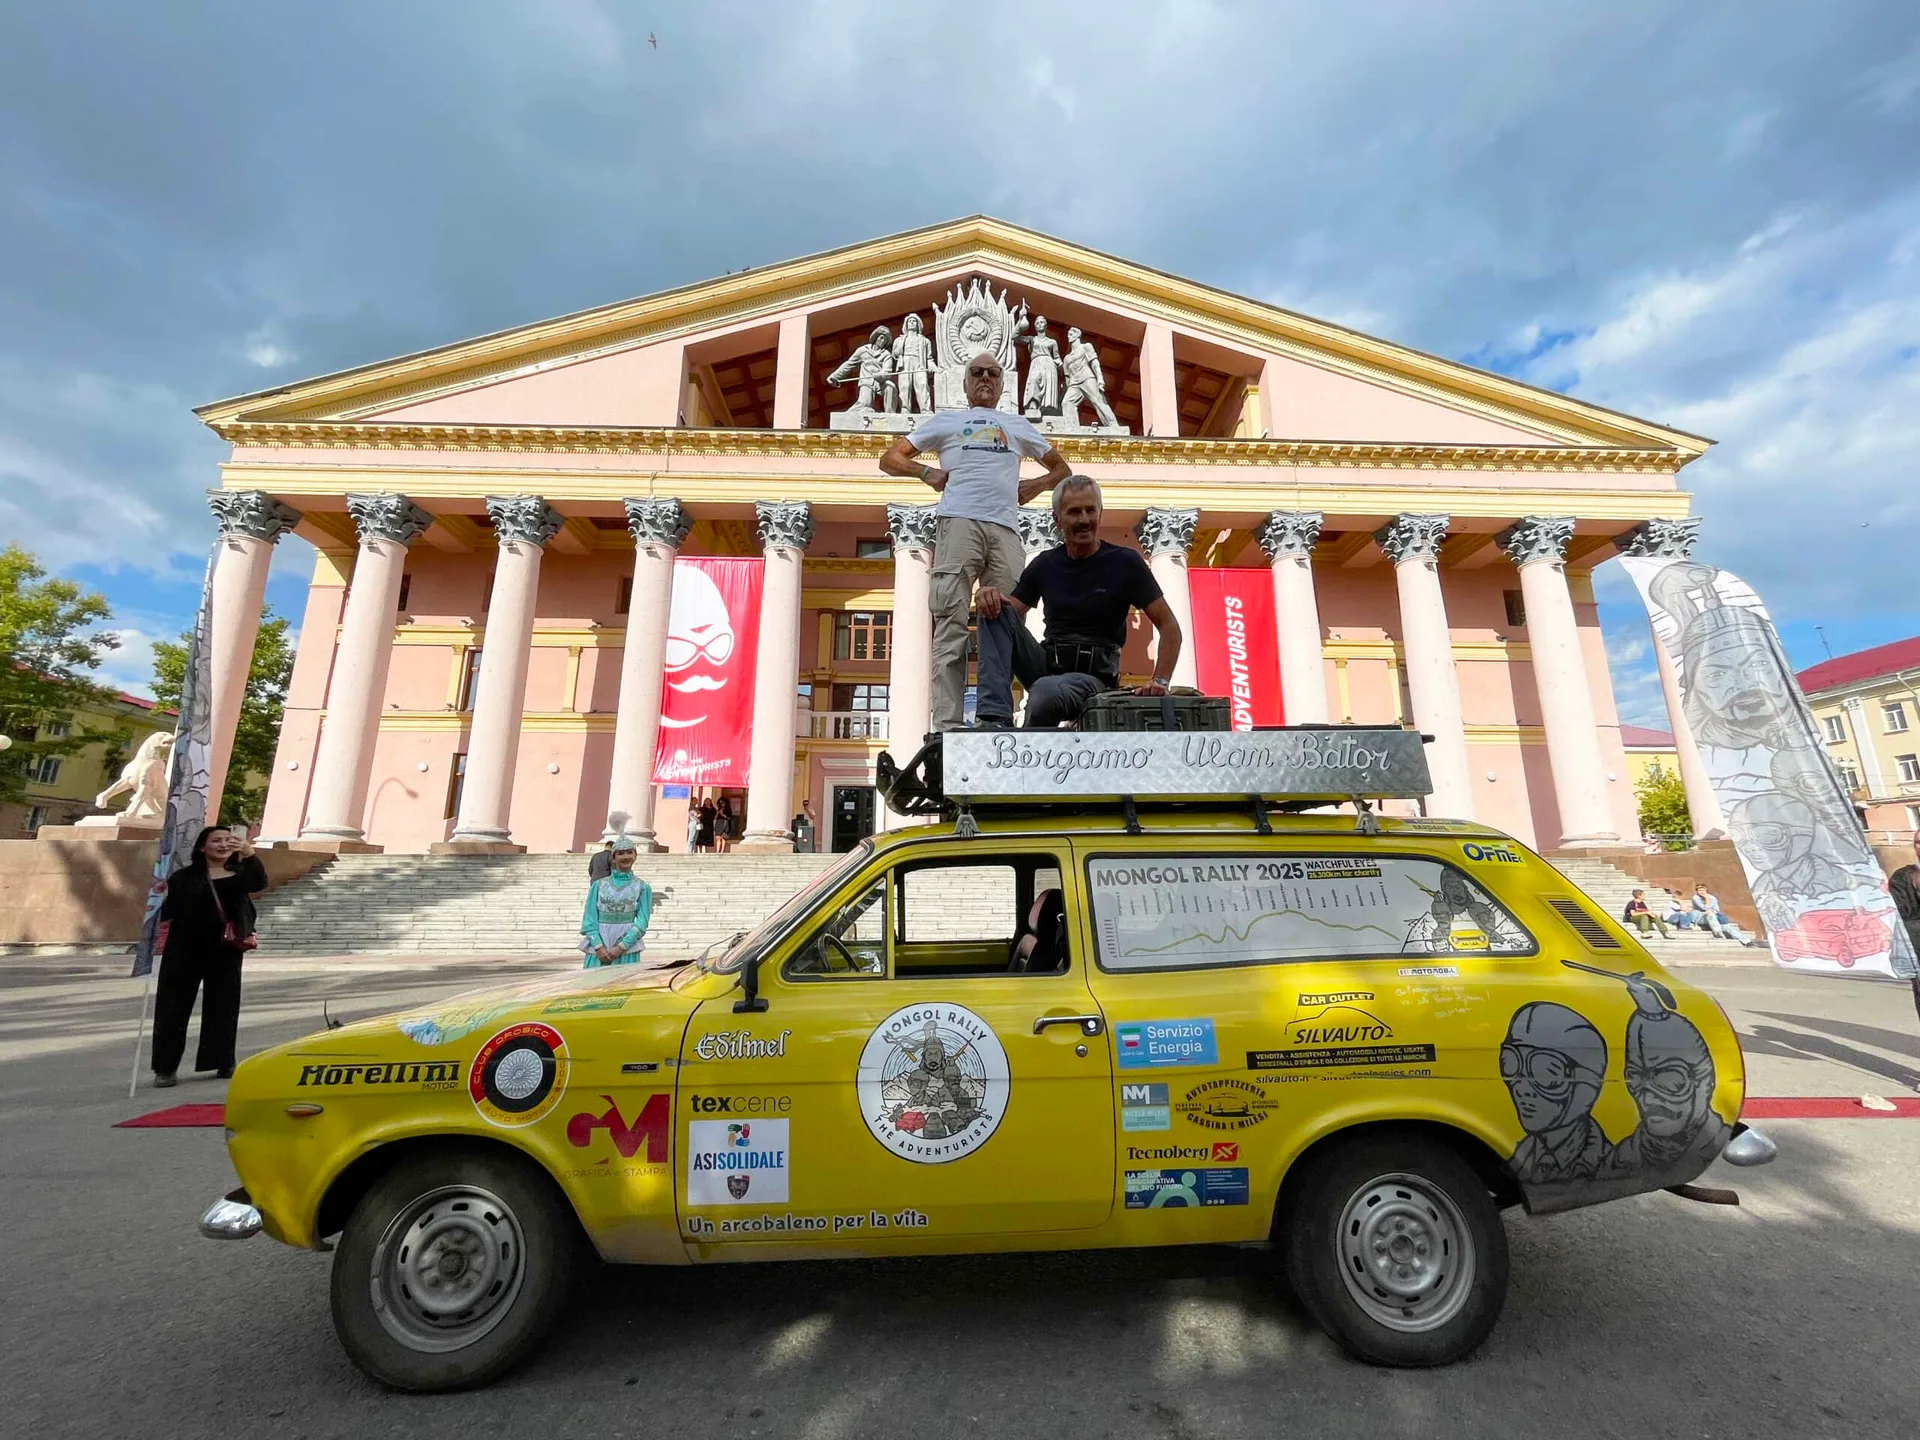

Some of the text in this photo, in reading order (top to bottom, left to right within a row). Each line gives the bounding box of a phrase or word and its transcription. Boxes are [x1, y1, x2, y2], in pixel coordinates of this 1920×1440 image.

[1225, 596, 1254, 731] ADVENTURISTS
[986, 733, 1153, 784] Bergamo
[1182, 734, 1274, 768] Ulan
[1305, 858, 1377, 869] WATCHFUL EYES
[1354, 869, 1380, 877] charity
[1096, 863, 1305, 887] MONGOL RALLY 2025
[1301, 993, 1373, 1005] CAR OUTLET
[881, 1009, 988, 1043] MONGOL RALLY
[1147, 1025, 1203, 1039] Servizio
[1294, 1025, 1385, 1044] SILVAUTO
[694, 1028, 792, 1060] Edilmel
[1149, 1041, 1203, 1056] Energia
[1290, 1051, 1331, 1059] ASSISTENZA
[1336, 1048, 1377, 1056] AUTOMOBILI
[473, 1026, 550, 1084] CLUB OROBICO
[1334, 1056, 1369, 1064] COLLEZIONE
[297, 1061, 462, 1086] Morellini
[1186, 1080, 1266, 1101] AUTOTAPPEZZERIA
[691, 1094, 792, 1114] texcene
[1187, 1112, 1227, 1130] CASSINA
[1230, 1121, 1235, 1130] E
[1238, 1111, 1268, 1128] MILESI
[874, 1114, 993, 1155] THE ADVENTURISTS
[693, 1150, 784, 1171] ASISOLIDALE
[1127, 1145, 1209, 1161] Tecnoberg
[563, 1168, 612, 1179] GRAFICA
[624, 1167, 667, 1177] STAMPA
[688, 1209, 928, 1233] Un arcobaleno per la vita
